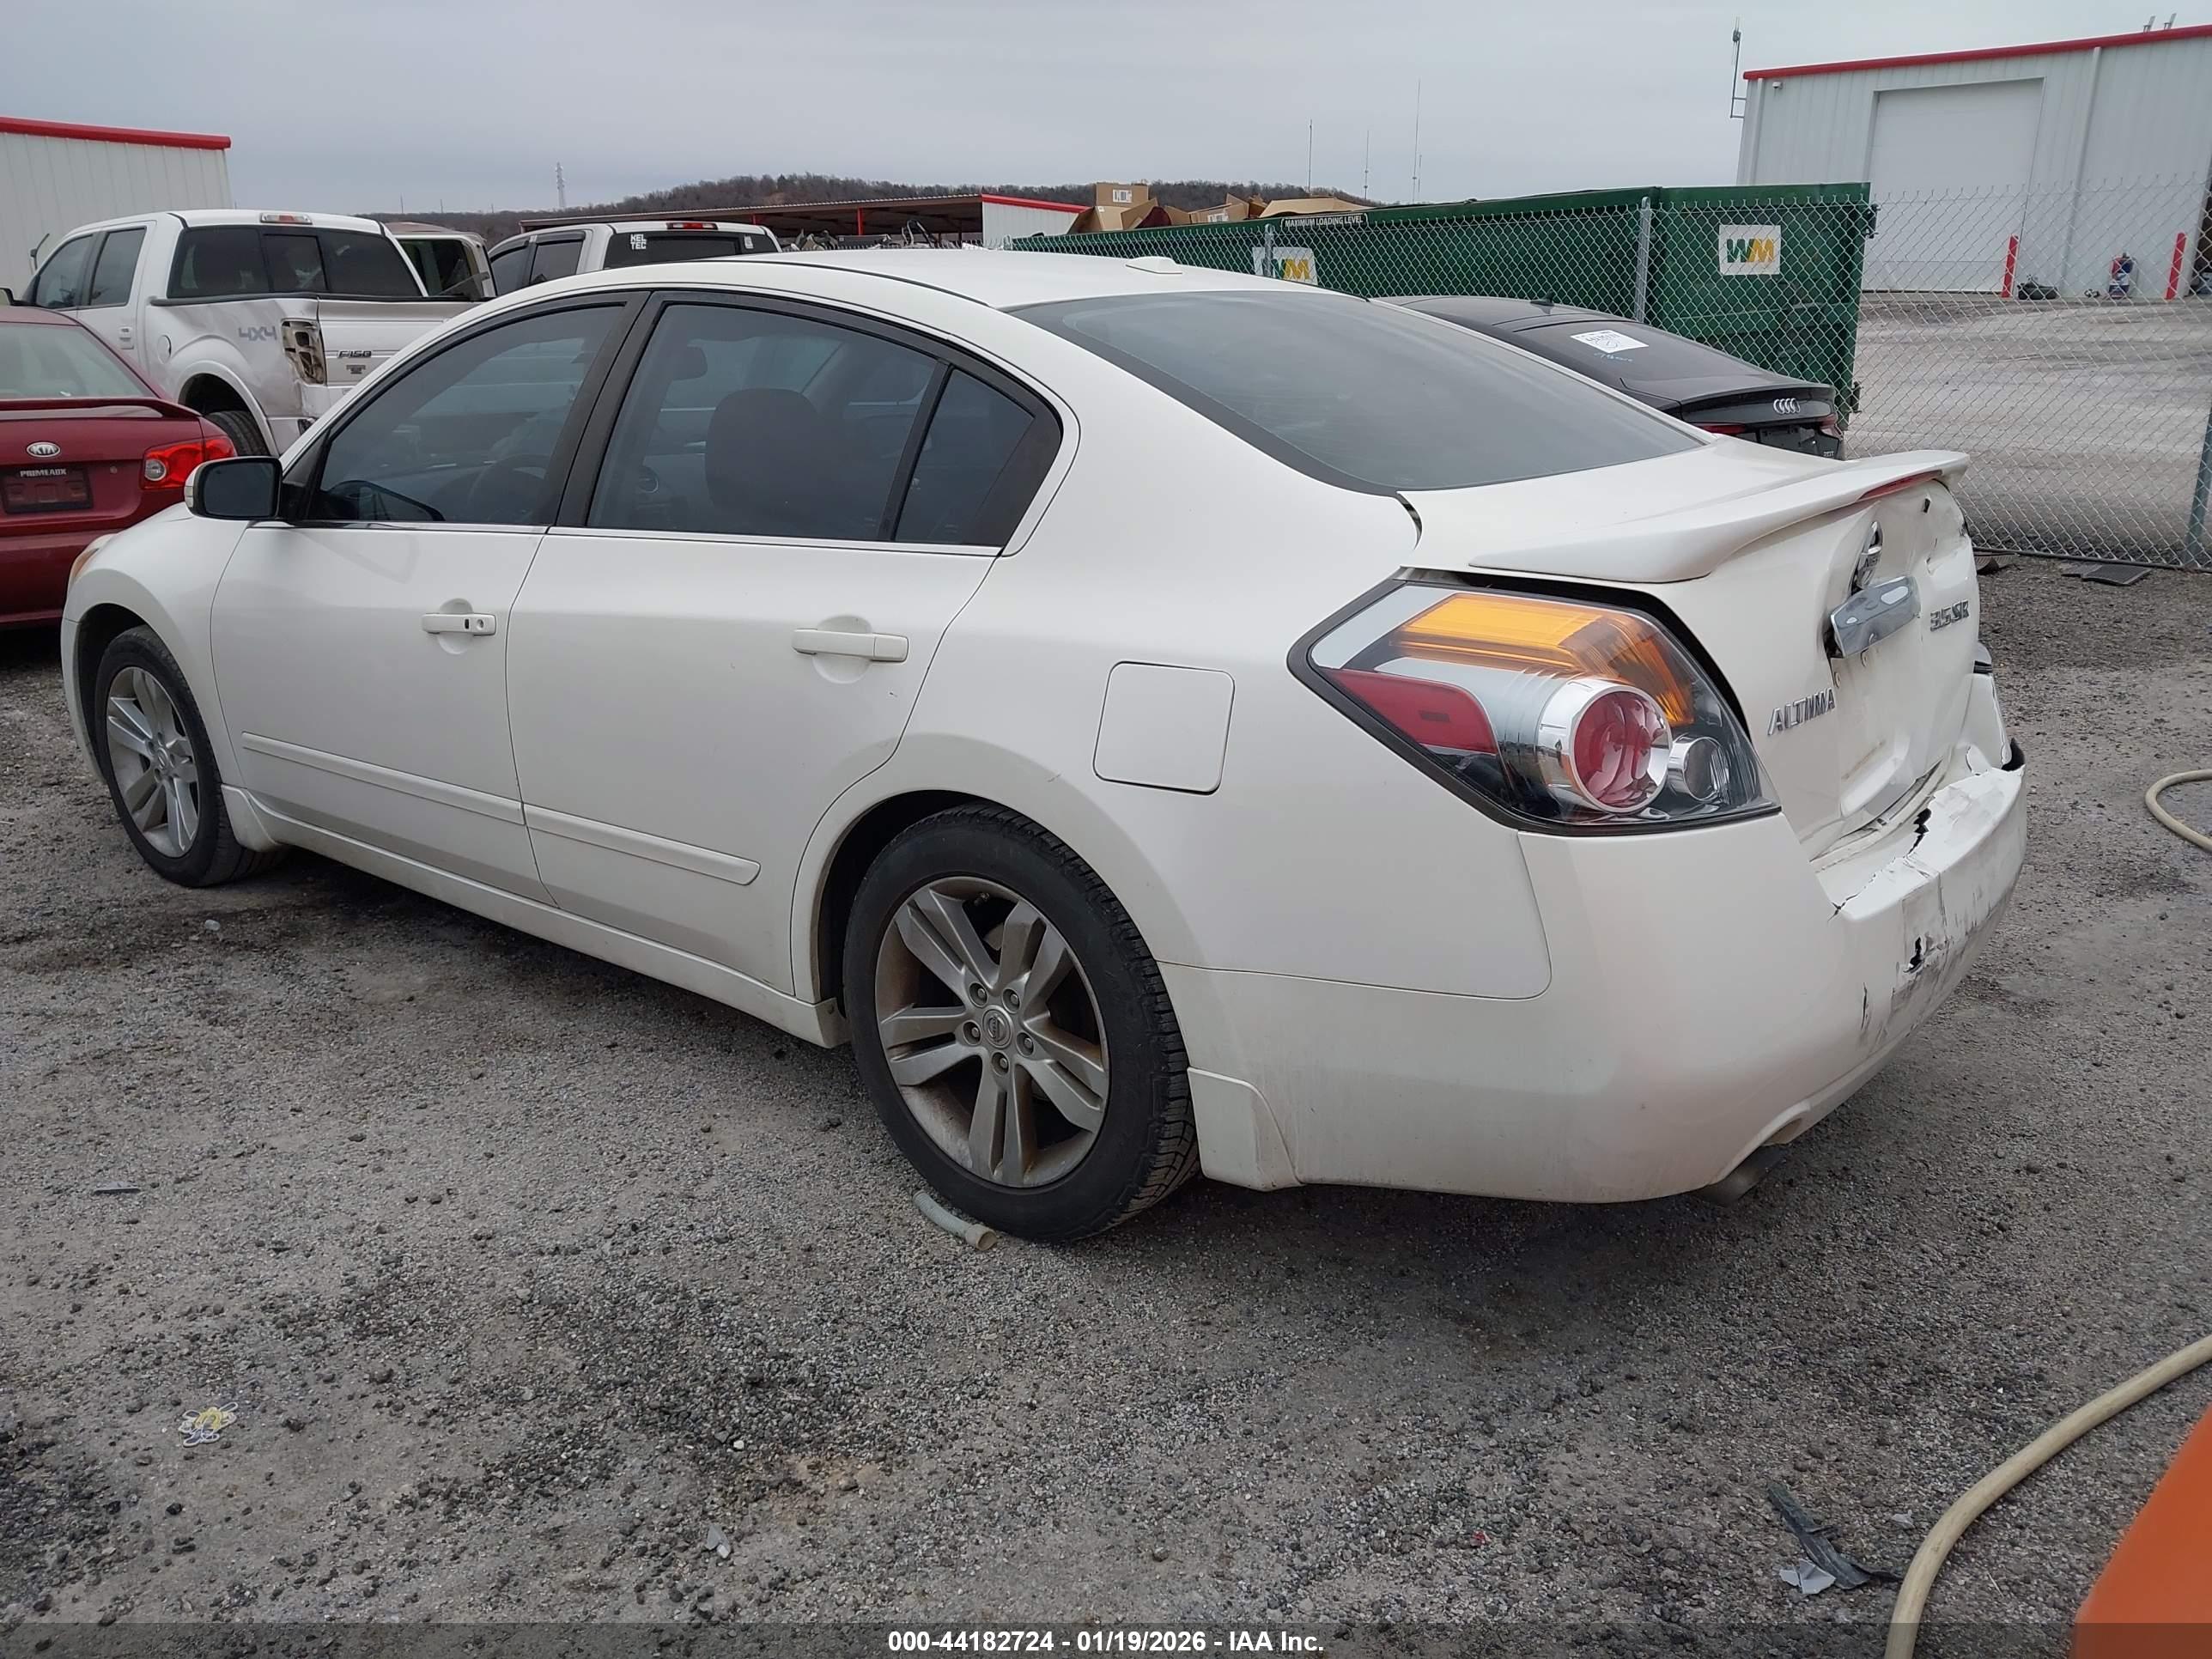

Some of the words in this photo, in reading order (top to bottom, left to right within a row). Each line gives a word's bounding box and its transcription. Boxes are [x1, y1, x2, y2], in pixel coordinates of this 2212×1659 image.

[1285, 218, 1316, 228] MAXIMUM
[1316, 216, 1344, 227] LOADING
[1345, 215, 1364, 224] LEVEL
[630, 234, 647, 242] KEL
[1726, 239, 1774, 263] WM
[1767, 687, 1835, 736] ALTIMA
